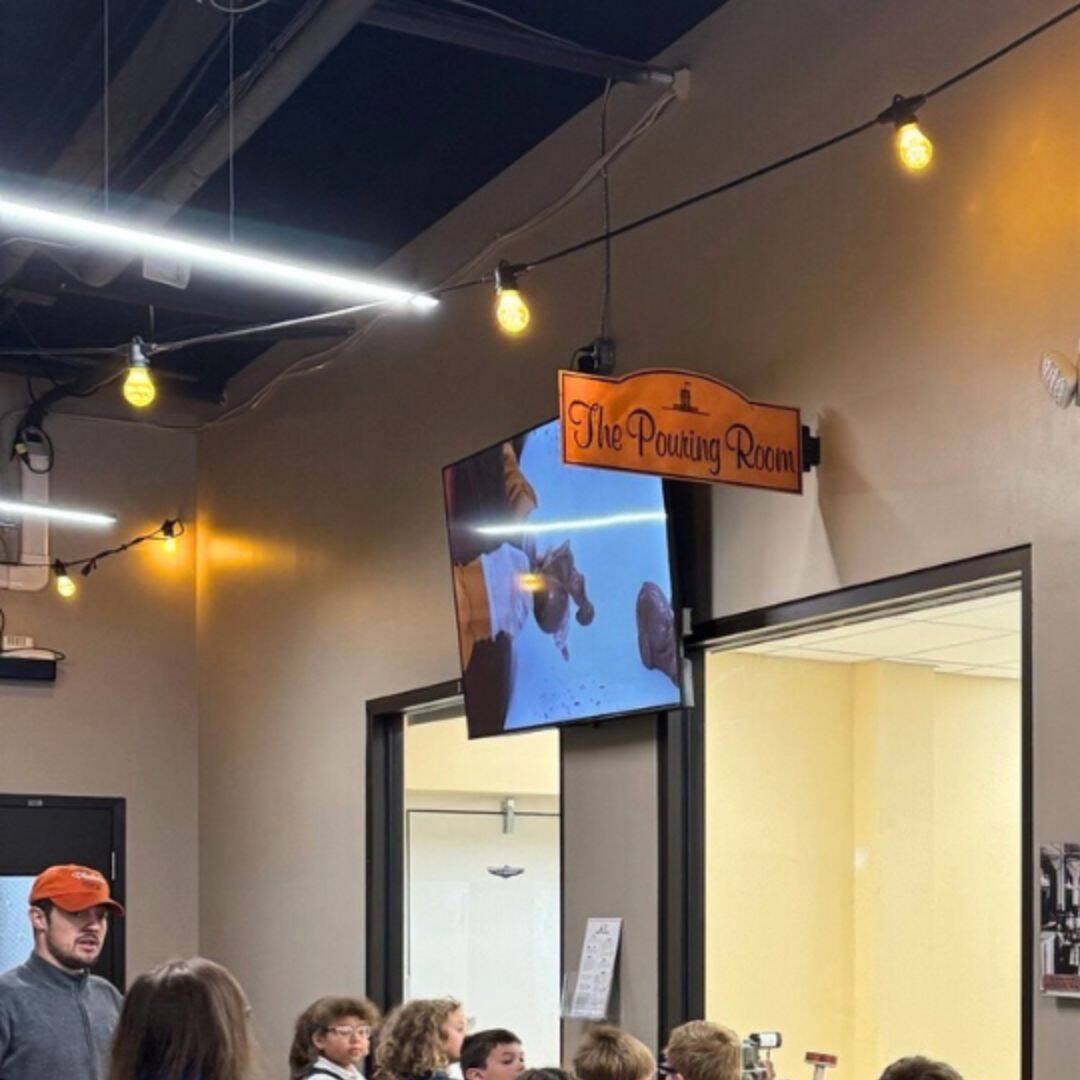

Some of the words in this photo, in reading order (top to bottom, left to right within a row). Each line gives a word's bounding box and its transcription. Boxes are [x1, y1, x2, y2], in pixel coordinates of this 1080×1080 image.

[568, 400, 623, 450] The
[626, 409, 721, 475] Pouring
[725, 423, 795, 473] Room
